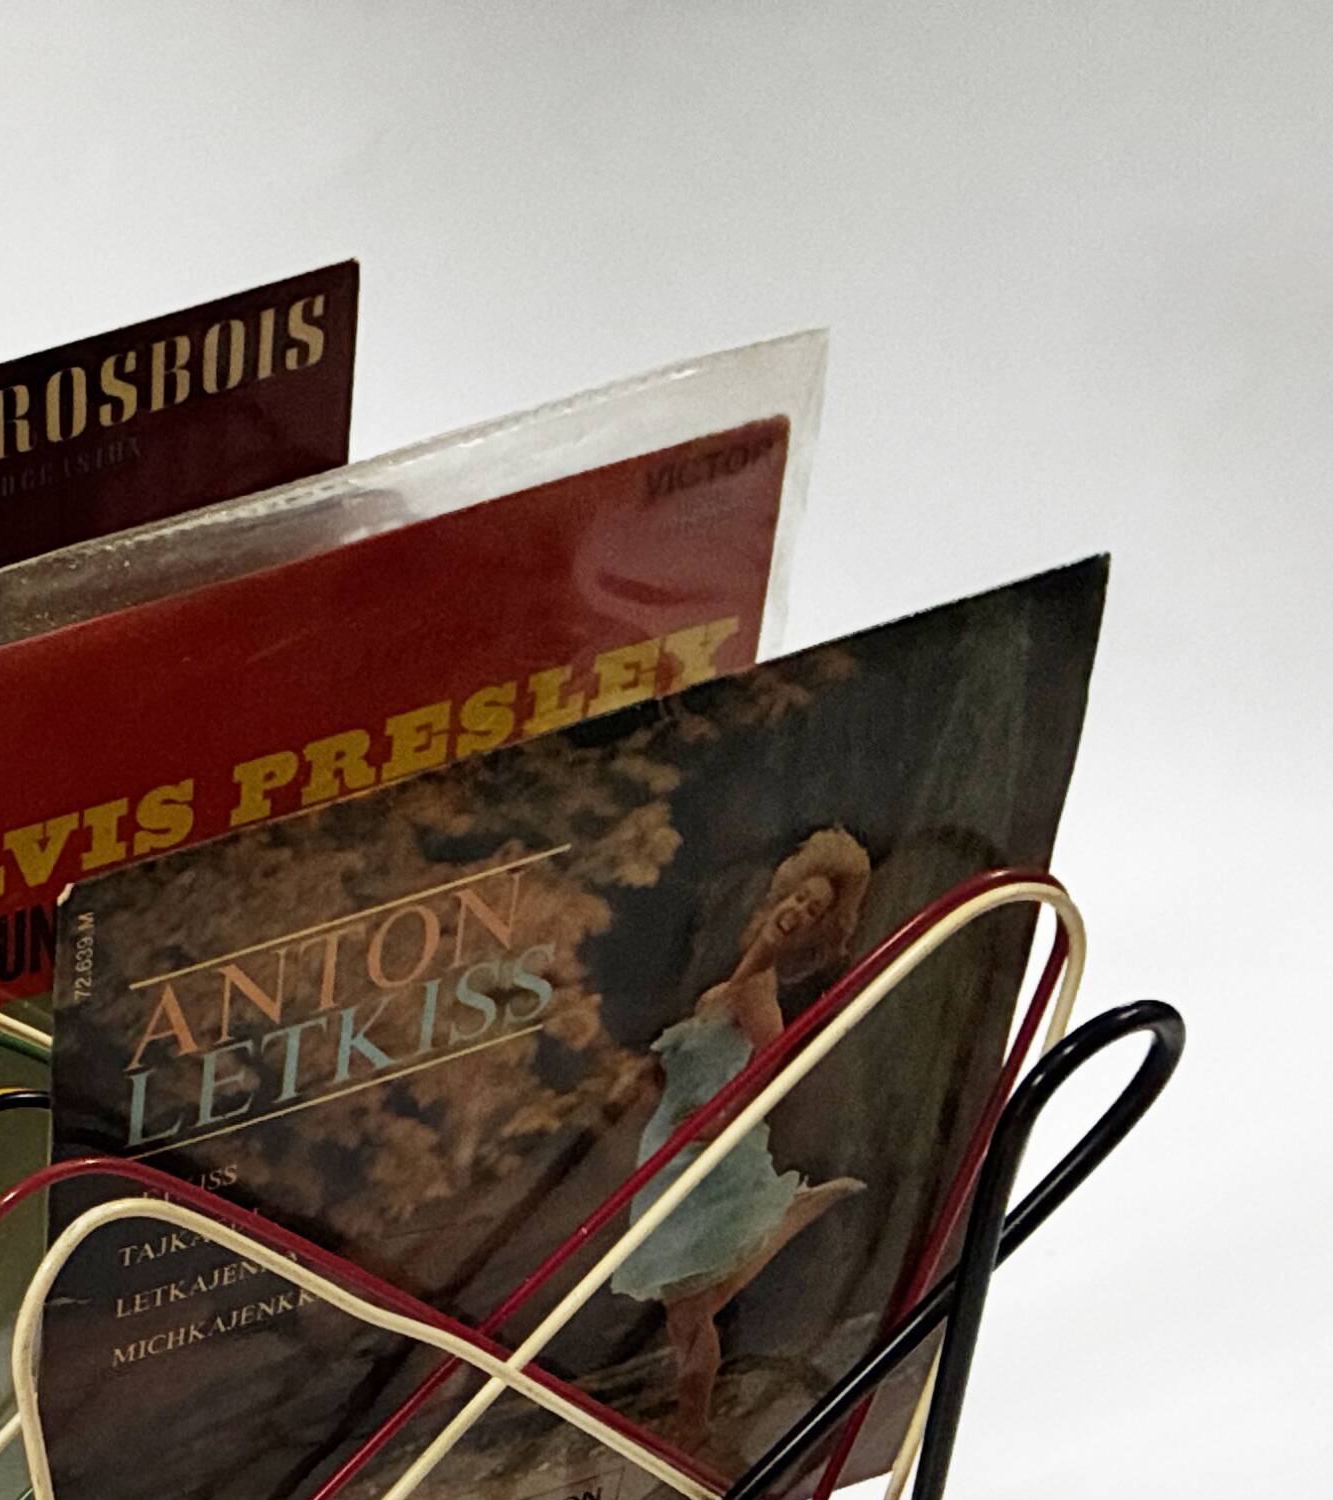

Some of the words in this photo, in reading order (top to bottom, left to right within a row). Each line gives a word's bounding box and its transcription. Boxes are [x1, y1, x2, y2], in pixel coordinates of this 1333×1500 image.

[231, 617, 738, 826] PRESLEY
[122, 942, 555, 1148] LETKISS
[123, 868, 533, 1072] ANTON
